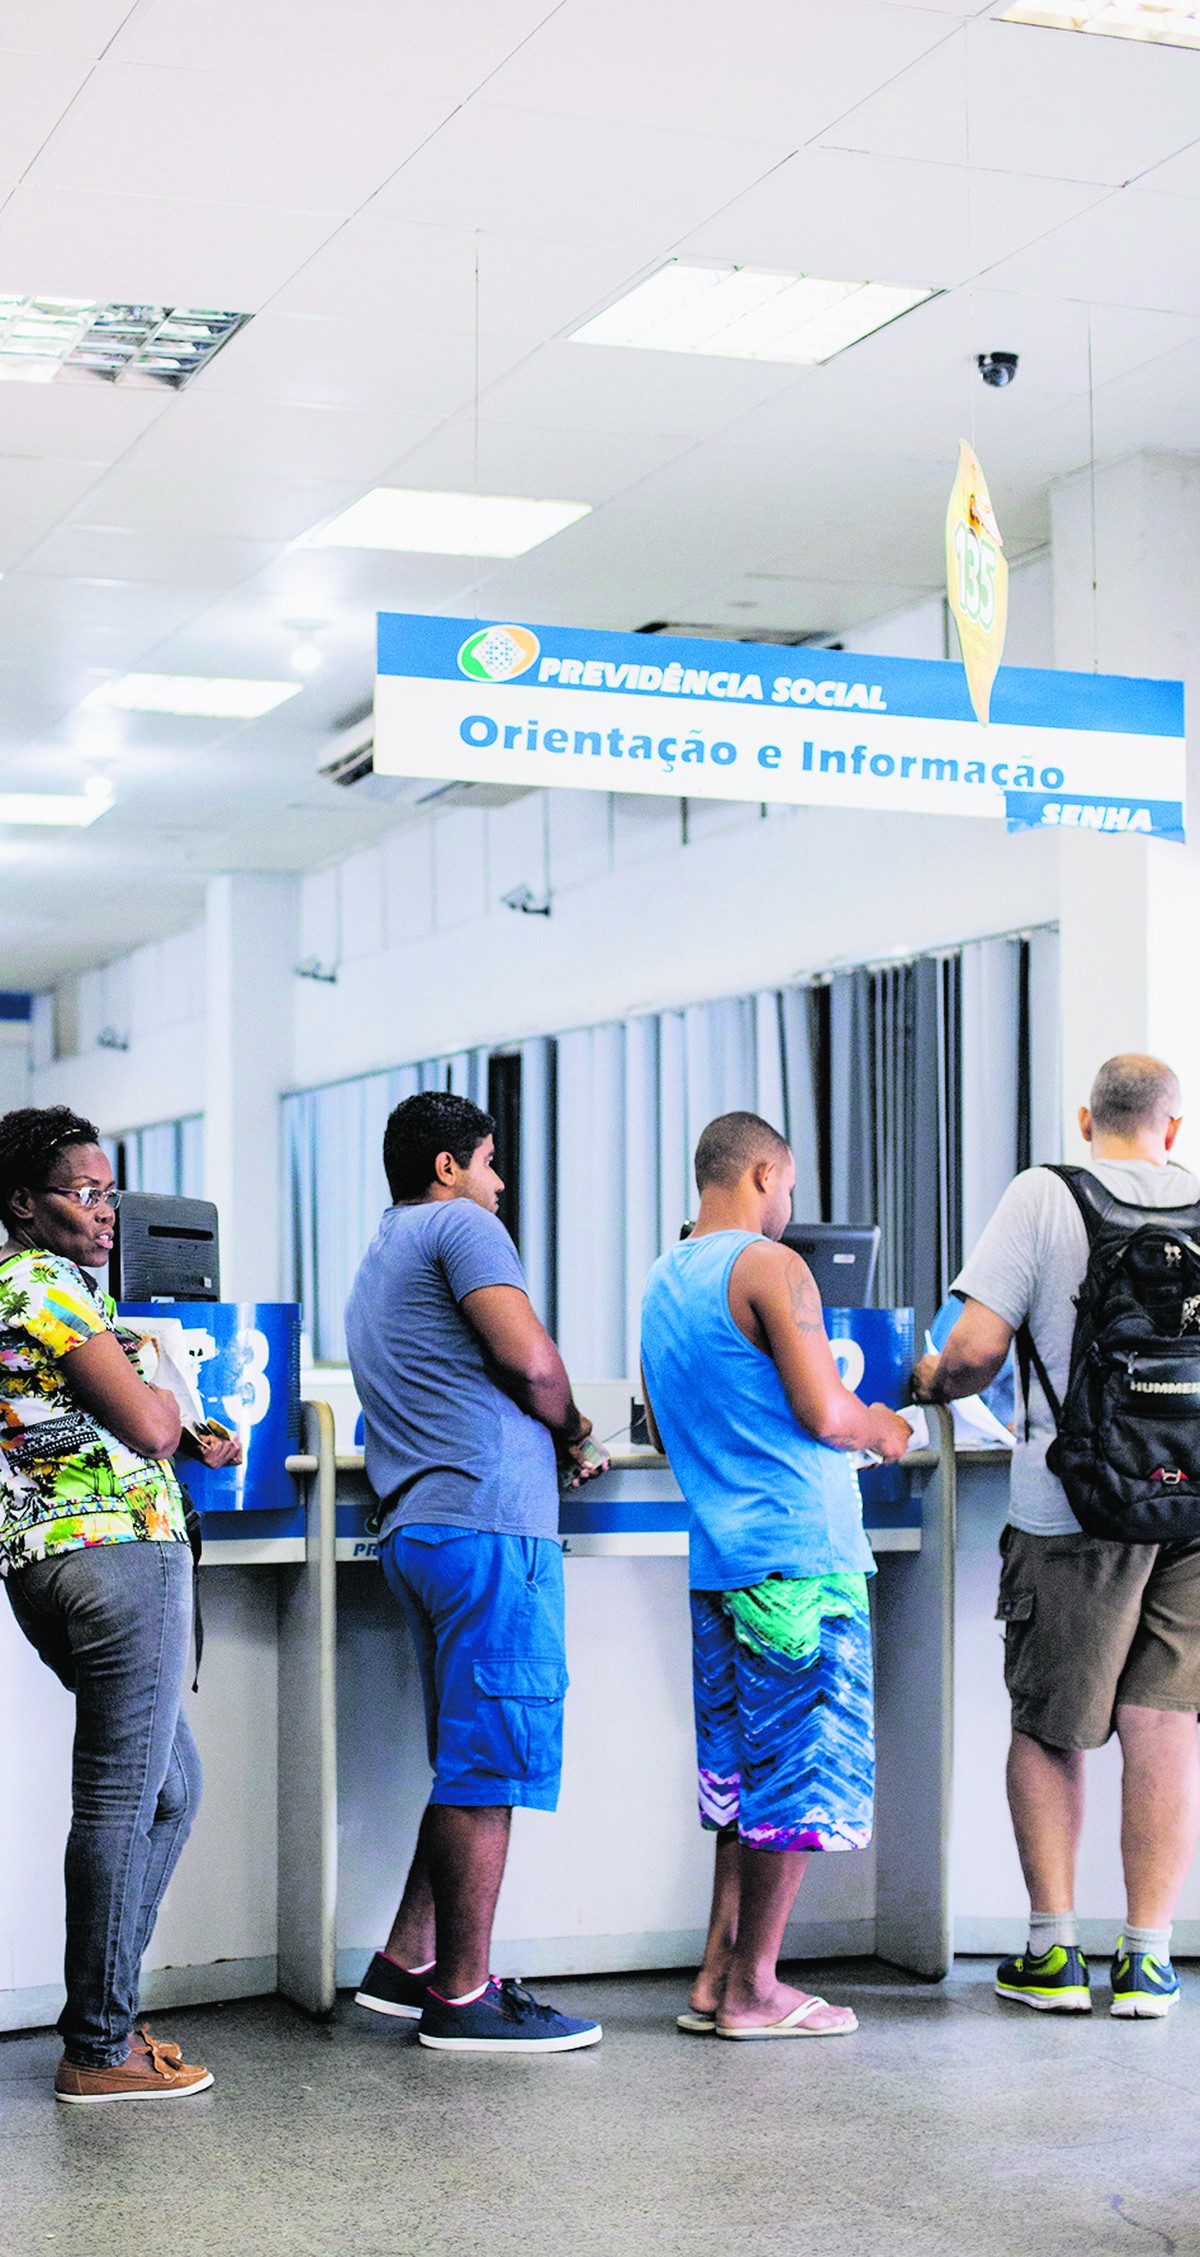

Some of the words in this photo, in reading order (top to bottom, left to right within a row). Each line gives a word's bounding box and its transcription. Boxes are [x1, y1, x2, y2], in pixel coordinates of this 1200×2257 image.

[953, 517, 997, 633] 135
[538, 656, 763, 700] PREVIDÊNCIA
[771, 676, 887, 710] SOCIAL
[459, 715, 738, 772] Orientação
[757, 743, 782, 769] e
[802, 740, 1065, 797] Informação
[1041, 802, 1152, 832] SENHA
[222, 1328, 271, 1426] 3
